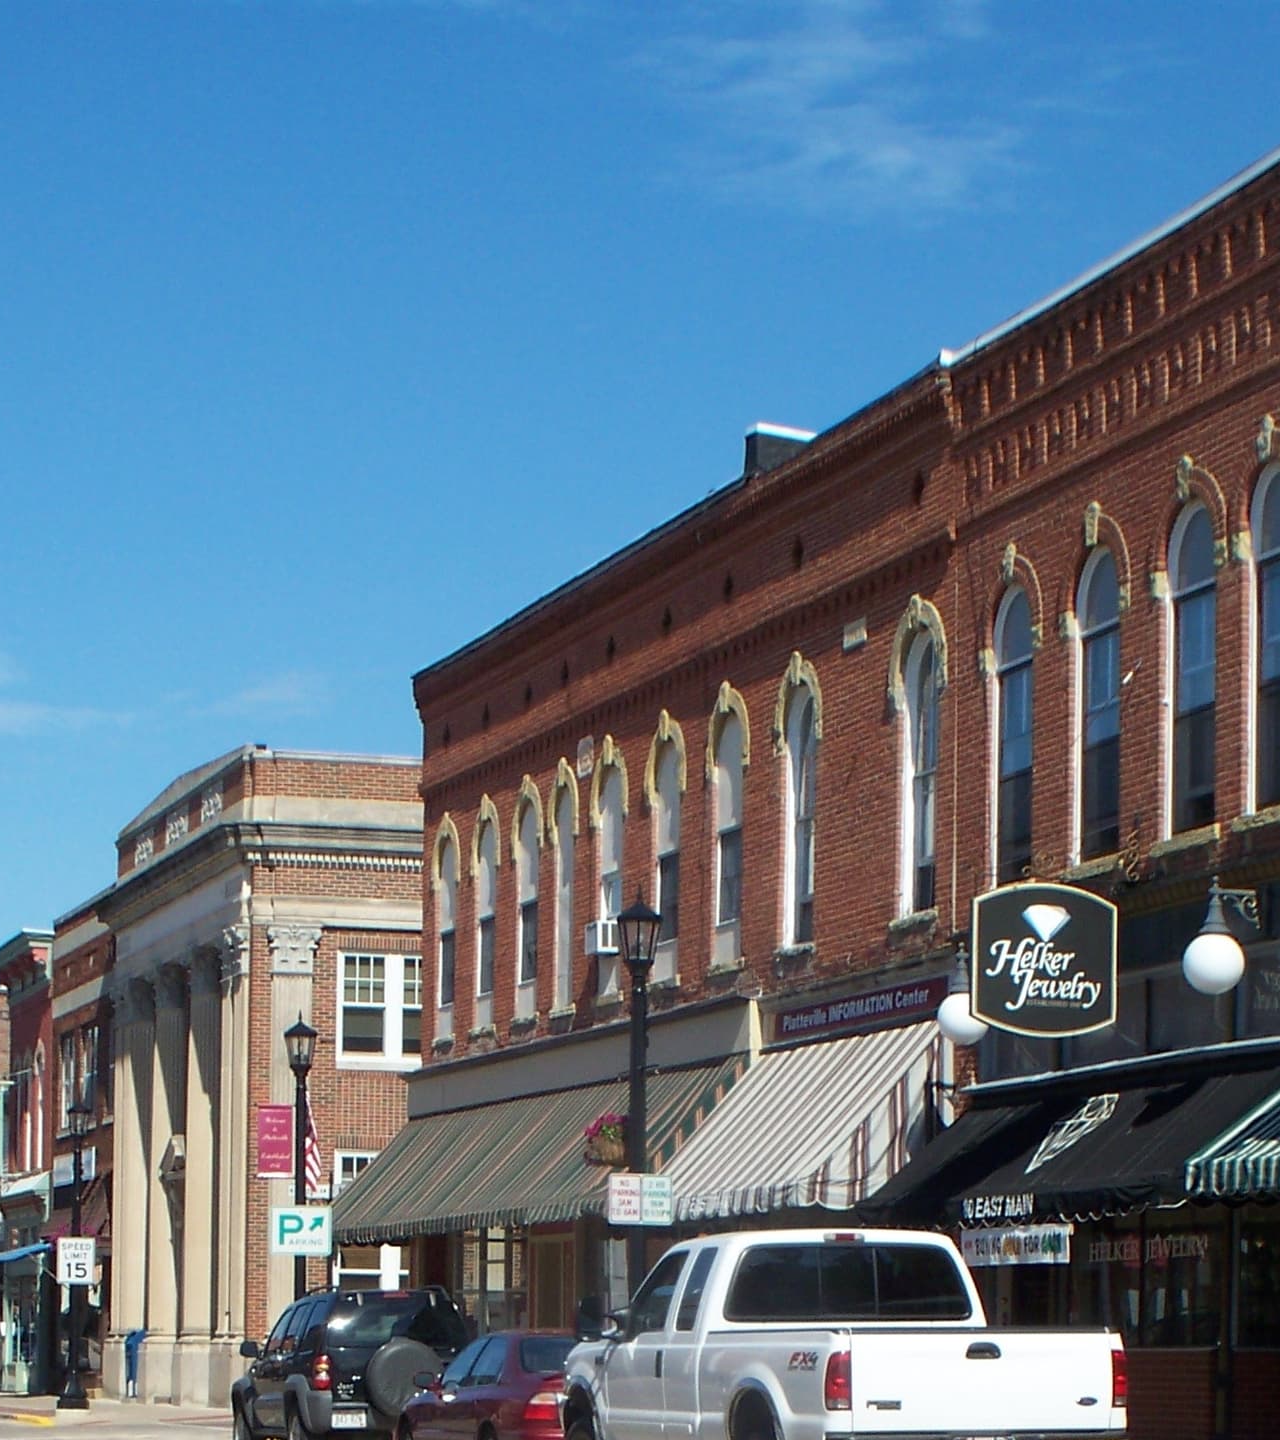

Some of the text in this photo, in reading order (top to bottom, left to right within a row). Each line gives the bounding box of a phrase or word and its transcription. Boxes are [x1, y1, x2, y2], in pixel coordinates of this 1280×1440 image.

[985, 936, 1076, 978] Helker
[1004, 968, 1102, 1011] Jewelry
[782, 987, 930, 1033] Platteville INFORMATION Center
[975, 1195, 1003, 1218] EAST
[1004, 1192, 1034, 1216] MAIN
[62, 1242, 92, 1251] SPEED
[64, 1252, 88, 1260] LIMIT
[66, 1262, 88, 1279] 15
[788, 1351, 819, 1366] FX4
